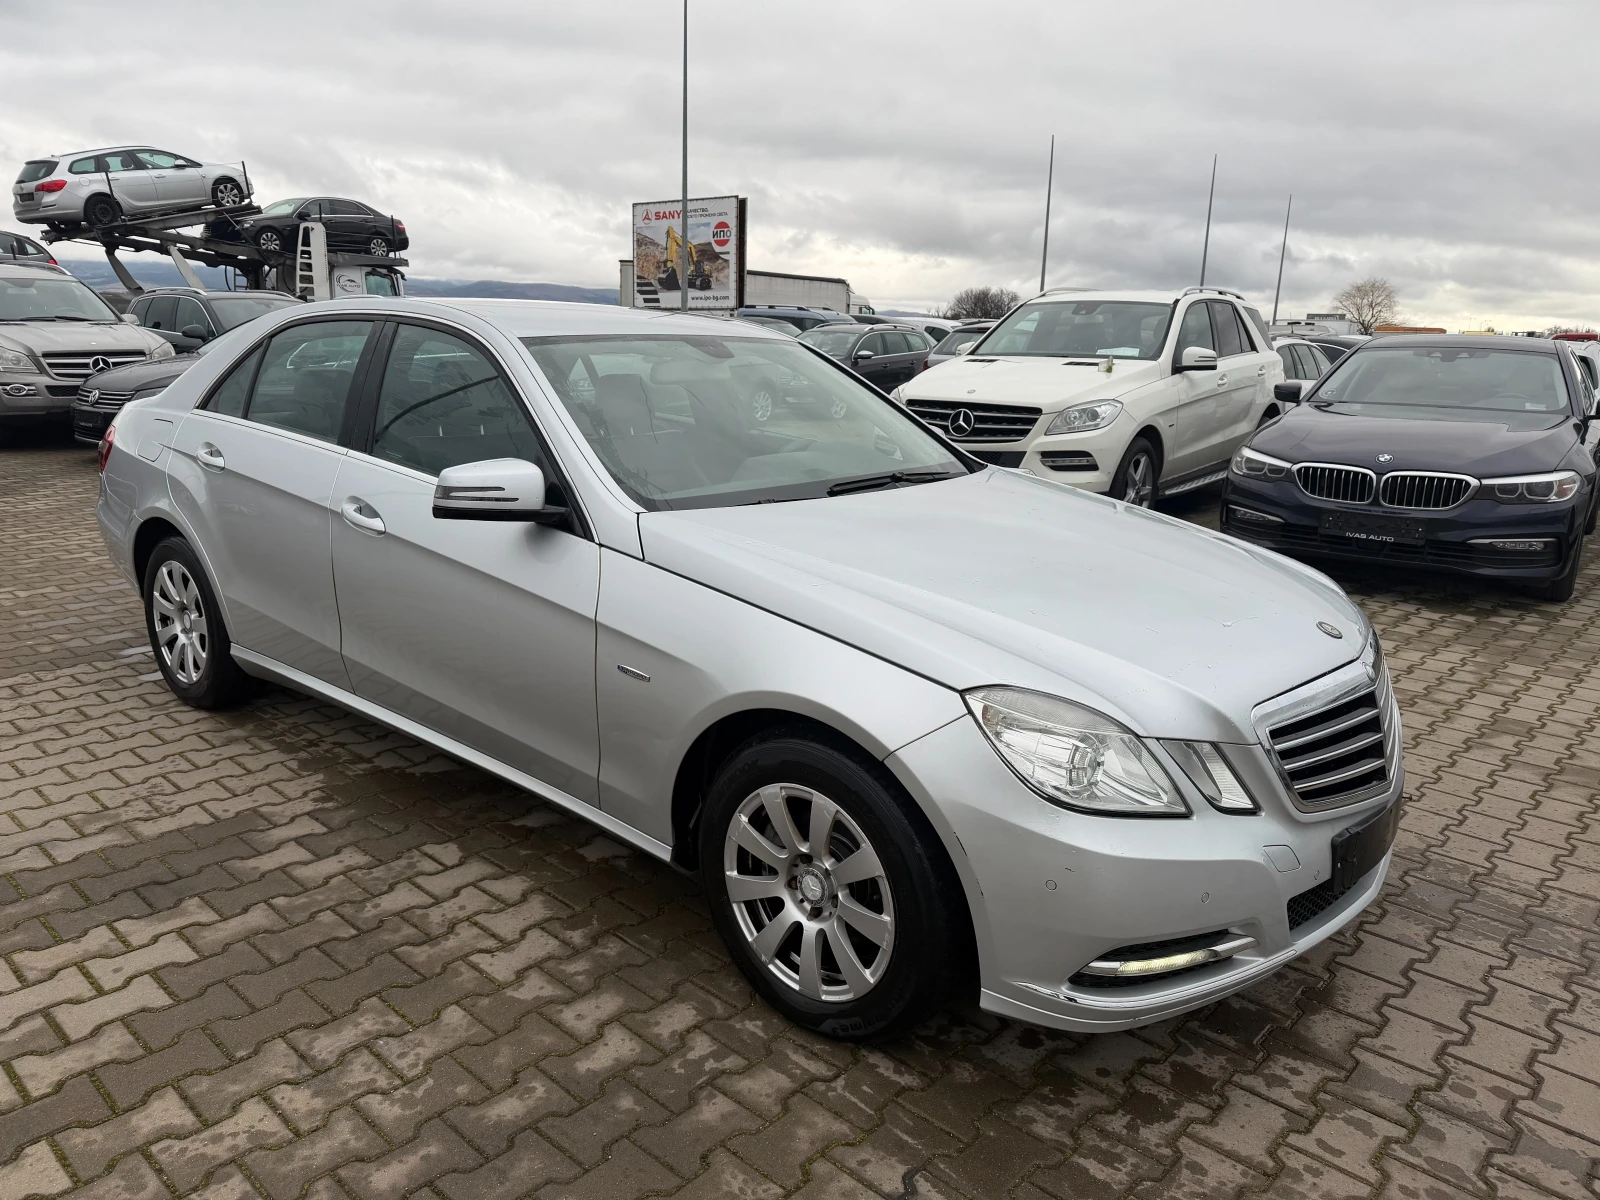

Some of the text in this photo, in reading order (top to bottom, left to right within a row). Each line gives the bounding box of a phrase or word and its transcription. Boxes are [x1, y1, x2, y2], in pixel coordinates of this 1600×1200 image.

[654, 209, 683, 221] SANY
[712, 229, 732, 239] ИПО
[1345, 531, 1395, 542] IVAS AUTO
